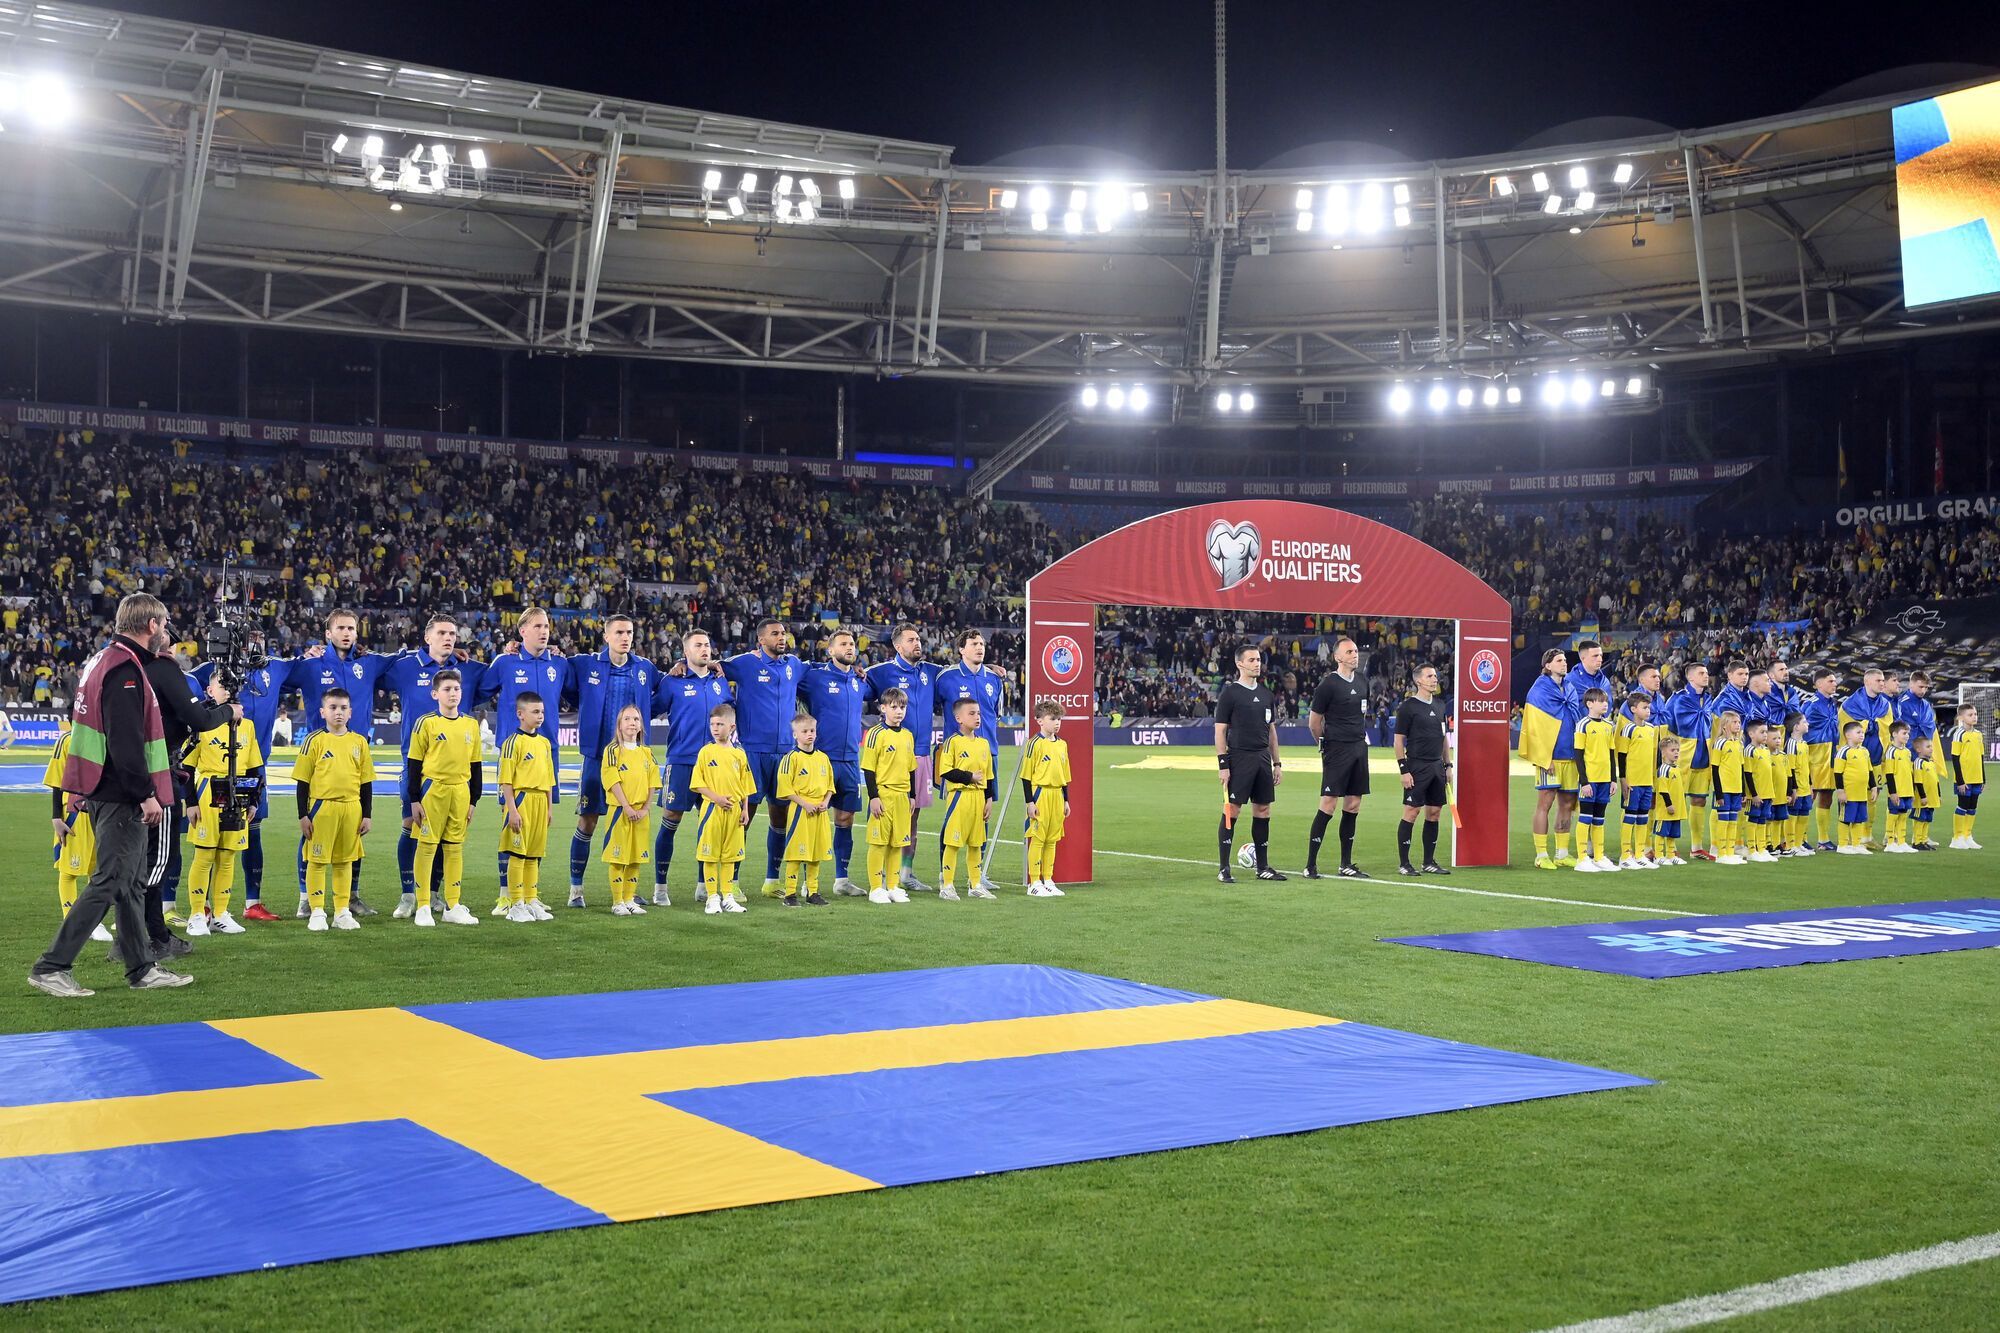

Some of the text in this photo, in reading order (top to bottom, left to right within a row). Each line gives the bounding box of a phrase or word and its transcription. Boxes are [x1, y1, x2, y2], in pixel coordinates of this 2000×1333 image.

[18, 407, 146, 430] LLOCNOU DE LA CORONA
[309, 429, 373, 446] GUADASSUAR
[436, 438, 466, 454] QUART
[469, 439, 480, 454] DE
[891, 467, 934, 481] PICASSENT
[1509, 473, 1616, 490] CAUDETE DE LAS FUENTES
[1069, 477, 1160, 493] ALBALAT DE LA RIBERA
[1175, 481, 1227, 495] ALMUSSAFES
[1243, 482, 1281, 495] BENICULL
[1283, 483, 1294, 495] DE
[1343, 481, 1408, 495] FUENTERROBLES
[1439, 479, 1493, 493] MONTSERRAT
[1835, 502, 1927, 526] ORGULL
[1271, 540, 1351, 561] EUROPEAN
[1262, 558, 1362, 584] QUALIFIERS
[1050, 639, 1075, 650] UEFA
[1475, 652, 1496, 663] UEFA
[1463, 700, 1507, 712] RESPECT
[1132, 730, 1169, 745] UEFA
